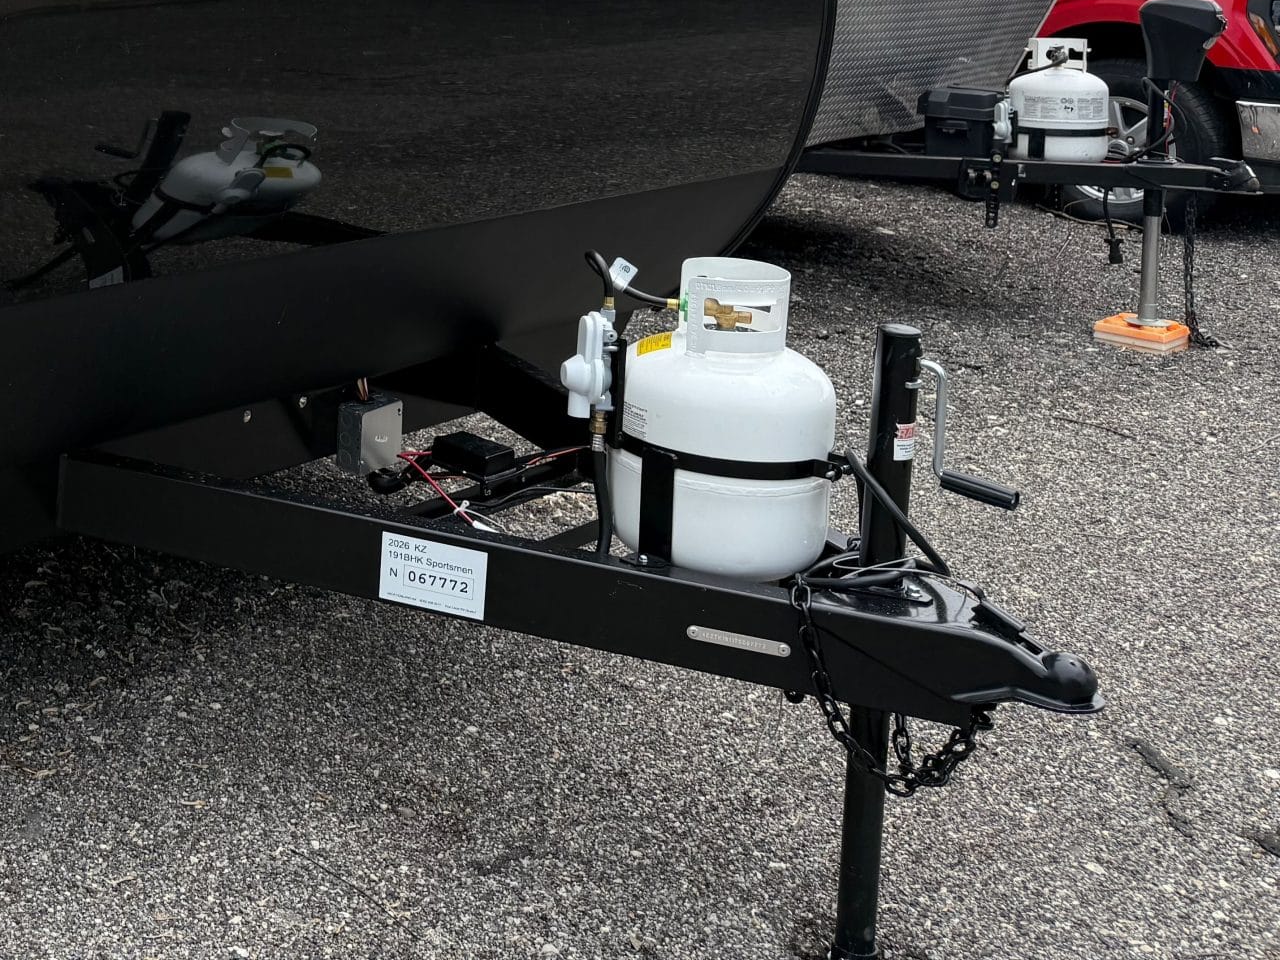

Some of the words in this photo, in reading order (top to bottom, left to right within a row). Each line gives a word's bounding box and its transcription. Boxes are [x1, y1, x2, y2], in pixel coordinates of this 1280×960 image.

[388, 538, 410, 550] 2026
[414, 543, 427, 554] KZ
[388, 550, 423, 565] 191BHK
[426, 558, 473, 575] Sportsmen
[389, 567, 398, 578] N
[408, 570, 469, 594] 067772
